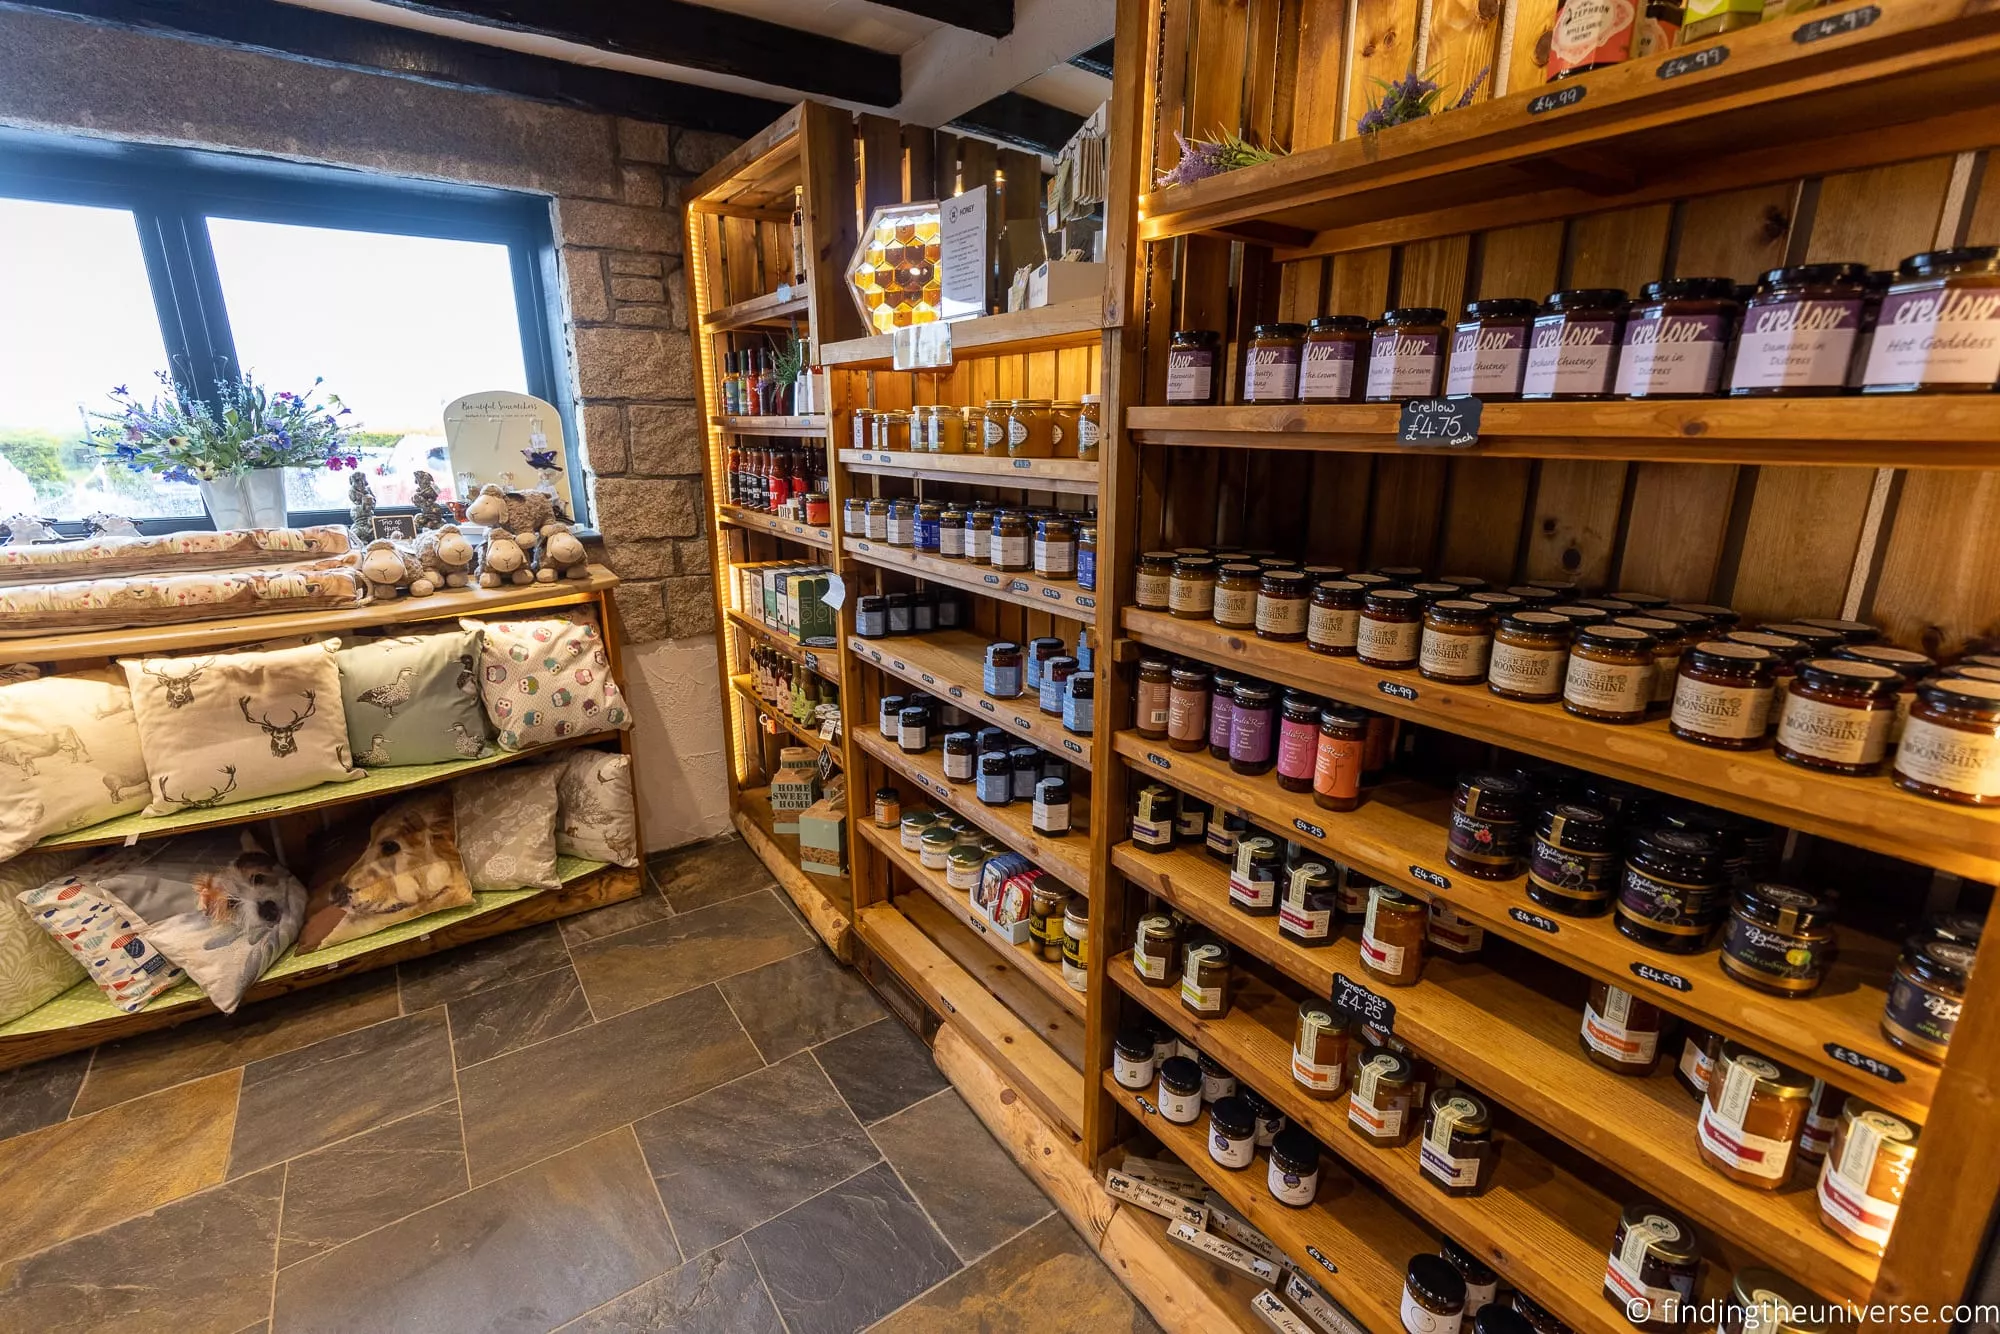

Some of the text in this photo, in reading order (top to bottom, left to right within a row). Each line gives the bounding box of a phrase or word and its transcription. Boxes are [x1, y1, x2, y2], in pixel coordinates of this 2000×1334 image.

[959, 204, 975, 216] HONEY
[1894, 288, 2000, 324] crellow
[1756, 301, 1850, 334] crellow
[1537, 321, 1603, 349] crellow
[1631, 316, 1708, 345] crellow
[1376, 335, 1429, 358] crellow
[1456, 328, 1514, 353] crellow
[1887, 335, 1996, 354] Hot Goddess
[1474, 360, 1509, 374] Chutney
[1556, 355, 1597, 370] Chutney
[1672, 354, 1685, 363] in
[462, 401, 496, 413] Beautiful
[1408, 400, 1456, 413] Crellow
[1405, 414, 1463, 441] £4.75
[1450, 432, 1474, 445] each
[780, 504, 792, 520] DIP
[1493, 661, 1548, 677] MOONSHINE
[1567, 676, 1626, 693] MOONSHINE
[1674, 698, 1740, 718] MOONSHINE
[1785, 716, 1868, 741] MOONSHINE
[772, 792, 811, 801] SWEET
[778, 783, 811, 792] HOME
[779, 800, 812, 809] HOME
[1295, 819, 1324, 838] £4.25
[1413, 867, 1446, 888] £4.99
[1516, 910, 1552, 927] £4.99
[1337, 974, 1387, 1010] Homecrafts
[1337, 988, 1383, 1021] £4.25
[1369, 1020, 1391, 1036] each
[1833, 1046, 1891, 1078] £3.99
[1713, 1129, 1739, 1153] Tomato
[1308, 1248, 1335, 1272] £4.25
